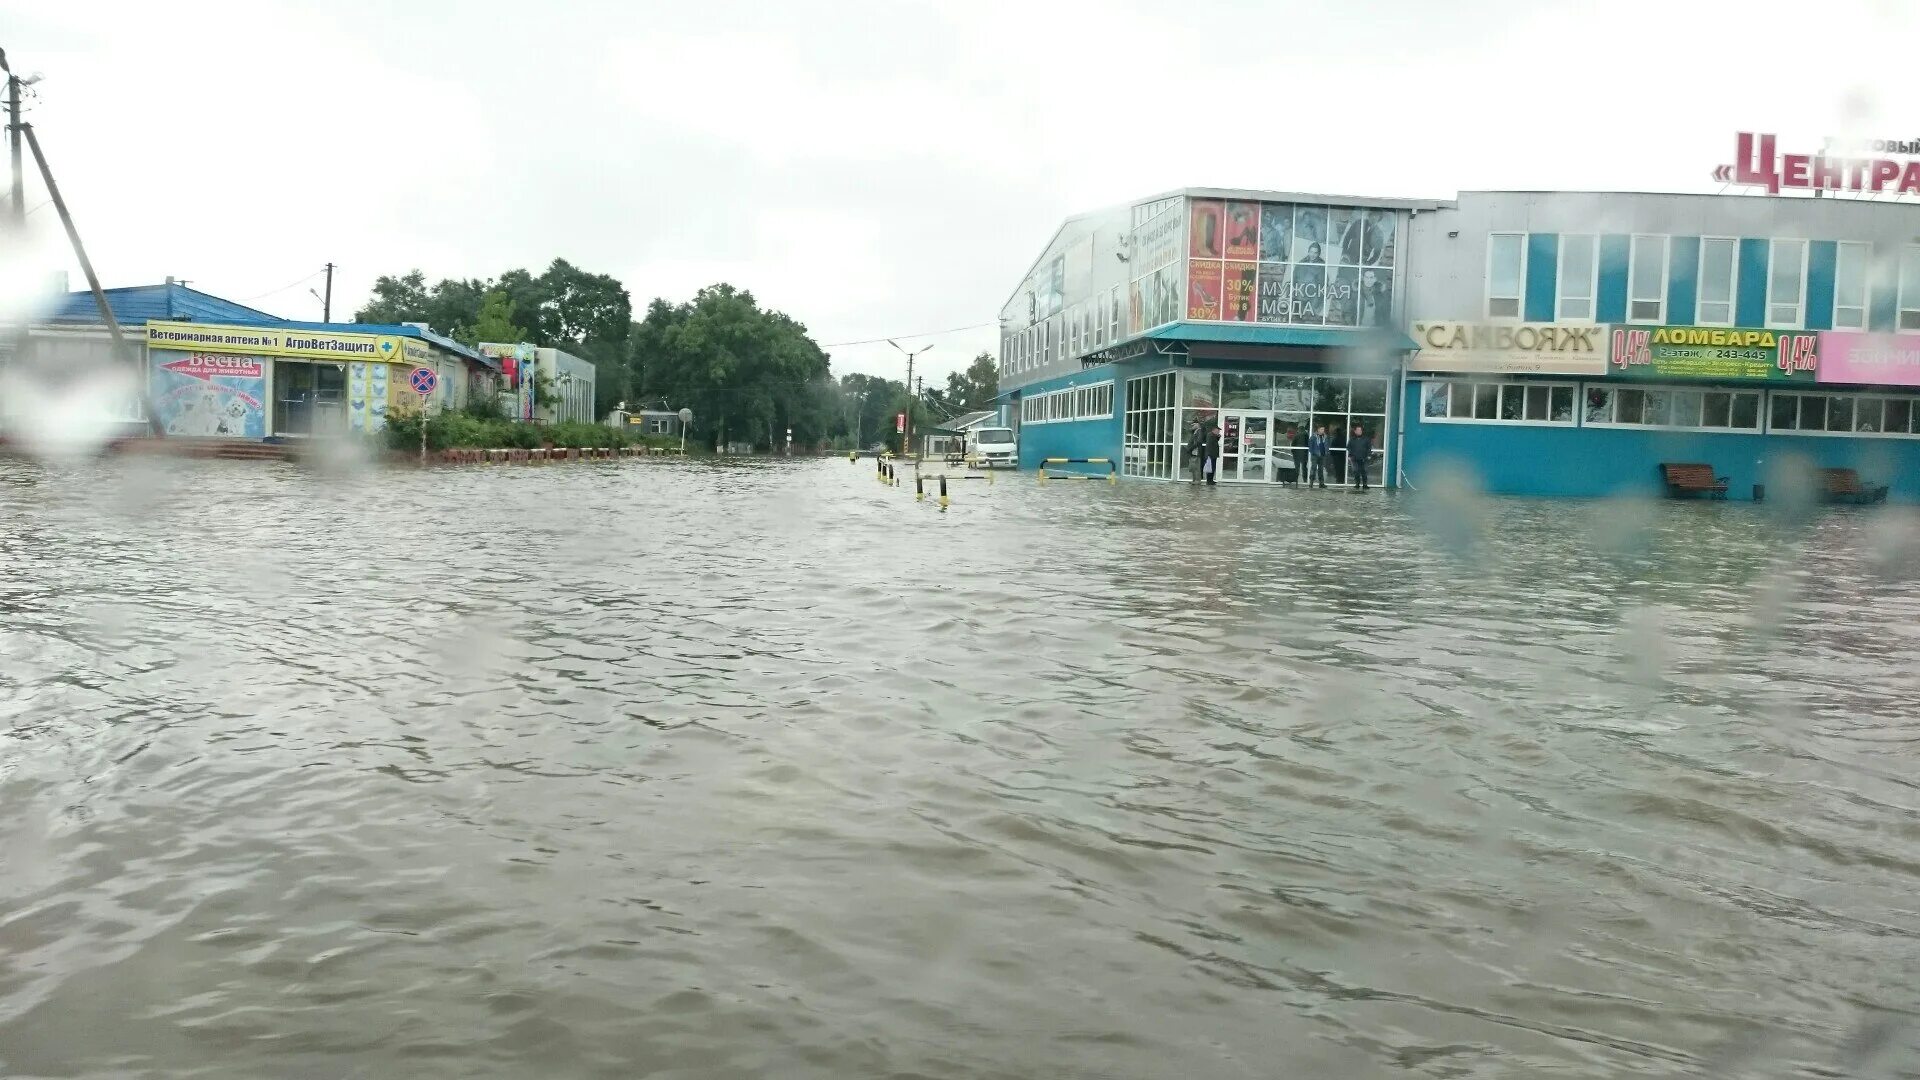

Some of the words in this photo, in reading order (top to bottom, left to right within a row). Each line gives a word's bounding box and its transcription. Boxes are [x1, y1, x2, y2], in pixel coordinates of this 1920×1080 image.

[1226, 279, 1254, 292] 30%
[1262, 281, 1351, 300] МУЖСКАЯ
[1228, 293, 1250, 302] Бутик
[1189, 307, 1217, 320] 30%
[1261, 299, 1315, 318] МОДА
[149, 328, 223, 344] Ветеринарная
[225, 335, 260, 346] аптека
[273, 337, 278, 347] 1
[286, 337, 375, 353] АгроВетЗащита
[1651, 328, 1777, 347] ЛОМБАРД
[1611, 329, 1652, 370] 0,4%
[1716, 349, 1767, 361] 243-445
[1777, 334, 1817, 375] 0,4%
[189, 351, 254, 369] Весна
